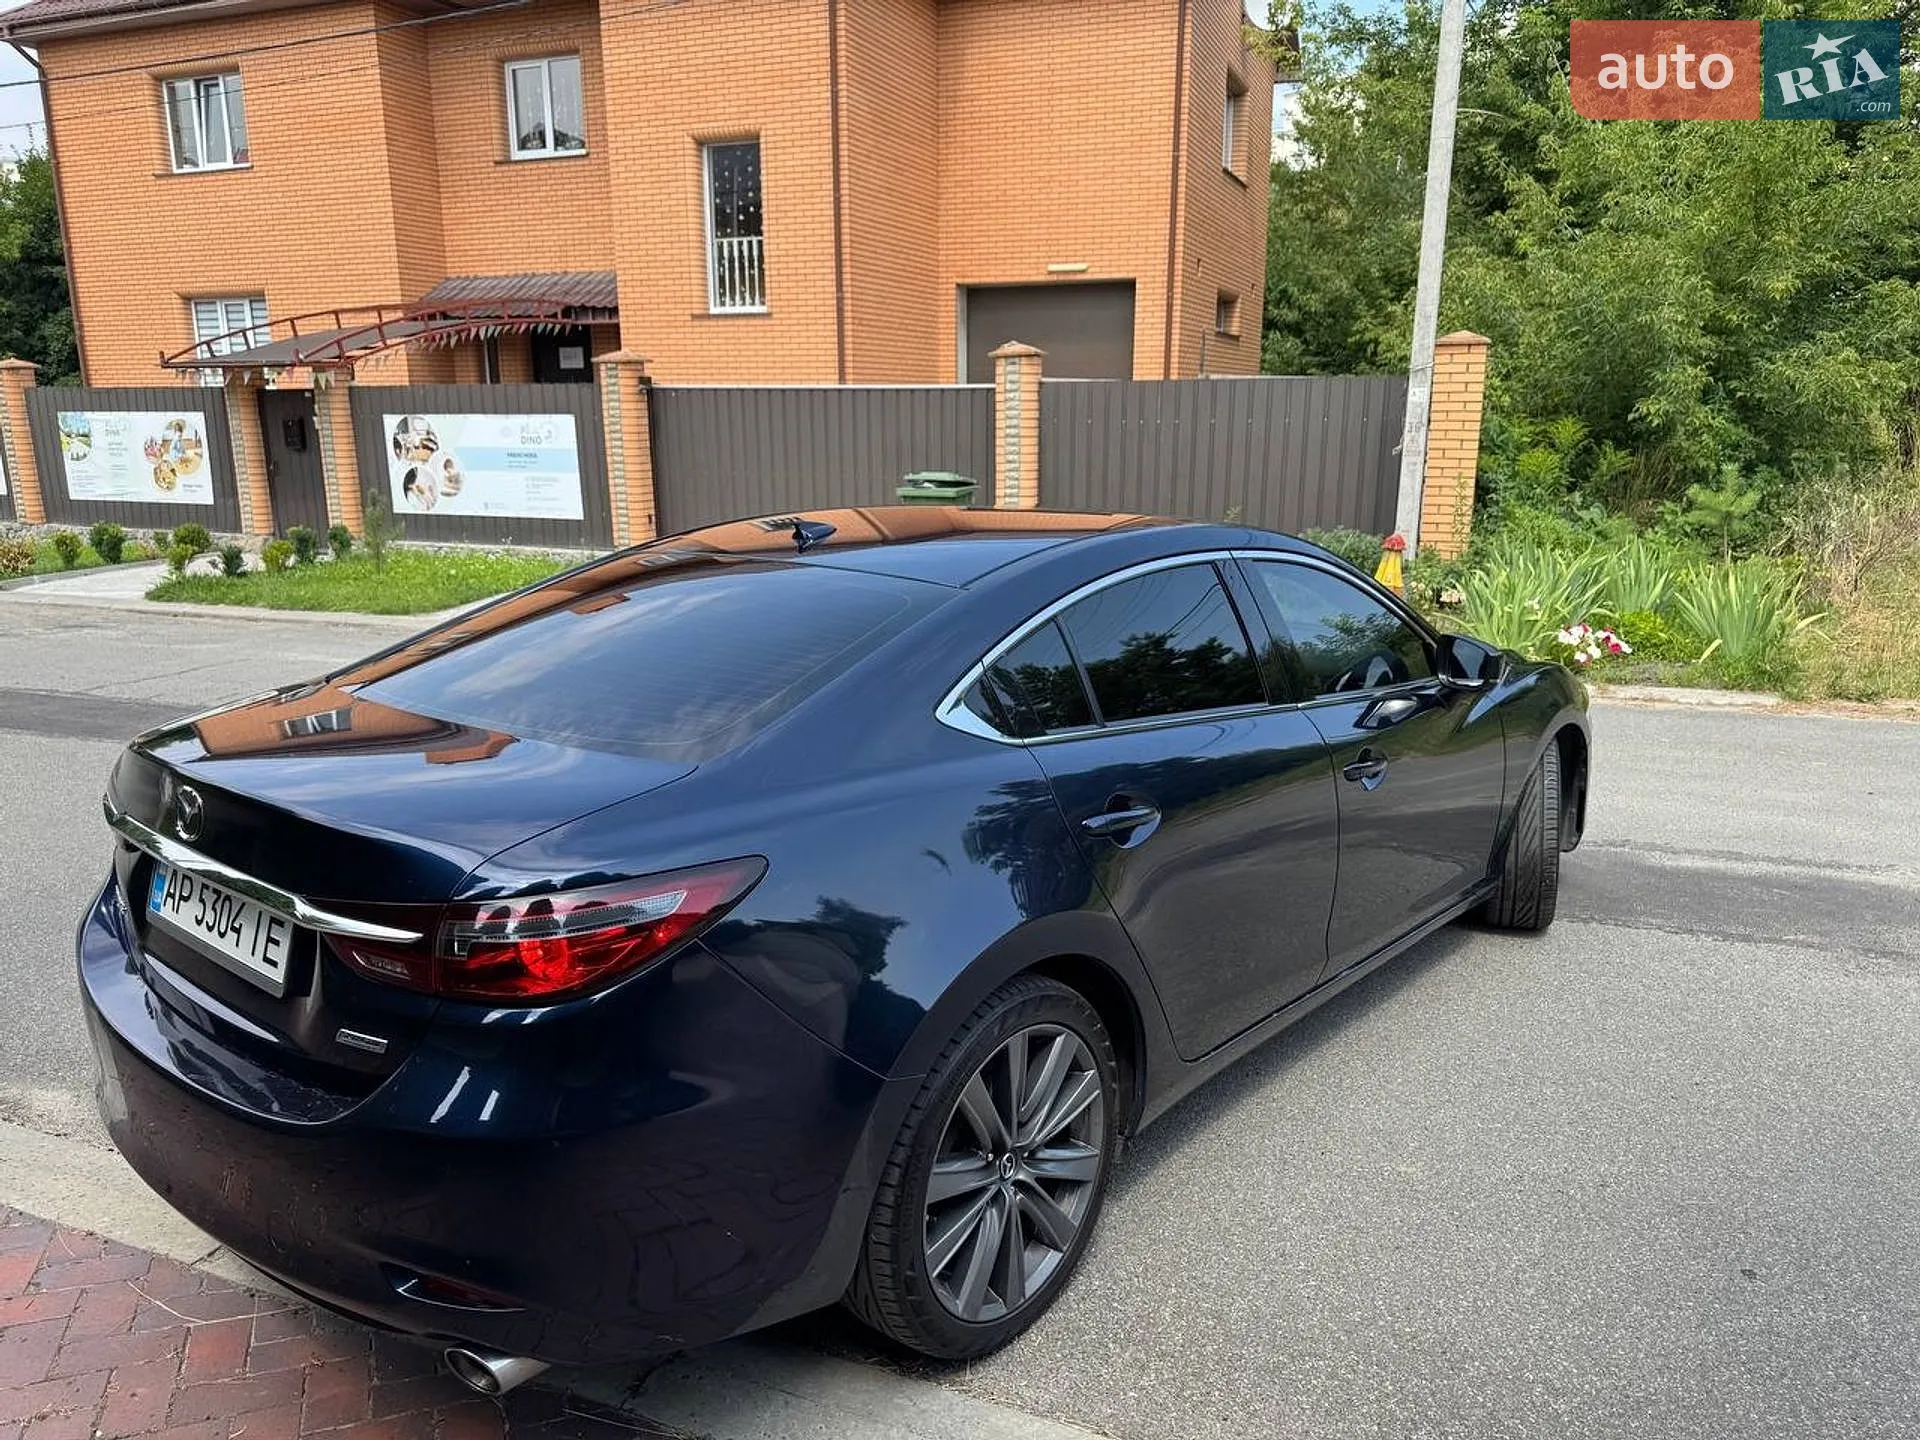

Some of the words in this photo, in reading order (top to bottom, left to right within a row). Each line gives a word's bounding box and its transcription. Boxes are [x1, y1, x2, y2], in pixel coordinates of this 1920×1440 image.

[520, 435, 543, 445] DINO
[163, 868, 194, 914] AP
[195, 882, 246, 948] 5304
[251, 910, 285, 969] IE
